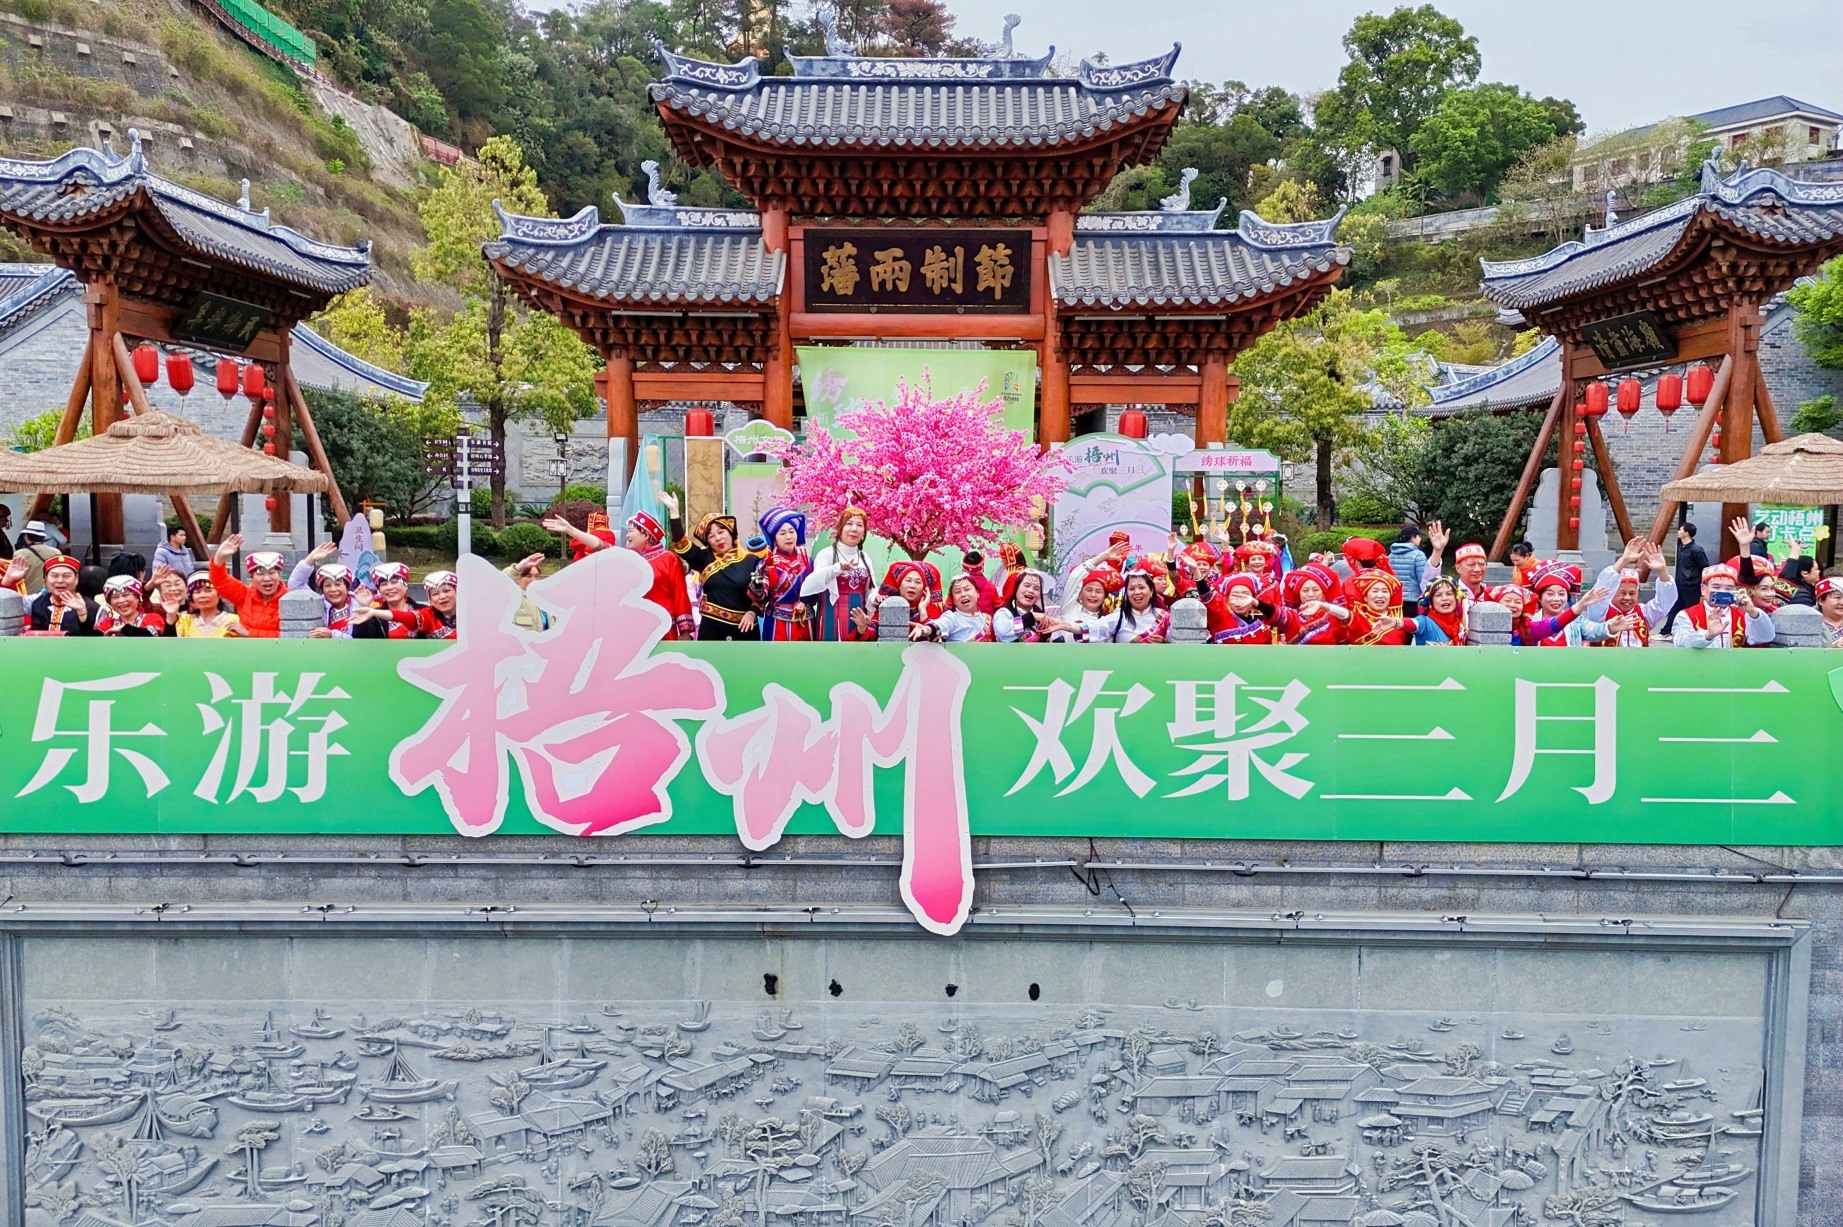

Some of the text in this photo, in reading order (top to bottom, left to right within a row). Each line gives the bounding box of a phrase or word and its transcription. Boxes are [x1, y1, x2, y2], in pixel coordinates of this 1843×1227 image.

[1201, 455, 1253, 467] 绣球祈福
[1754, 508, 1823, 527] 艺动梧州
[354, 526, 364, 551] 卫生间
[15, 552, 1797, 936] 乐游 梧州 欢聚三月三
